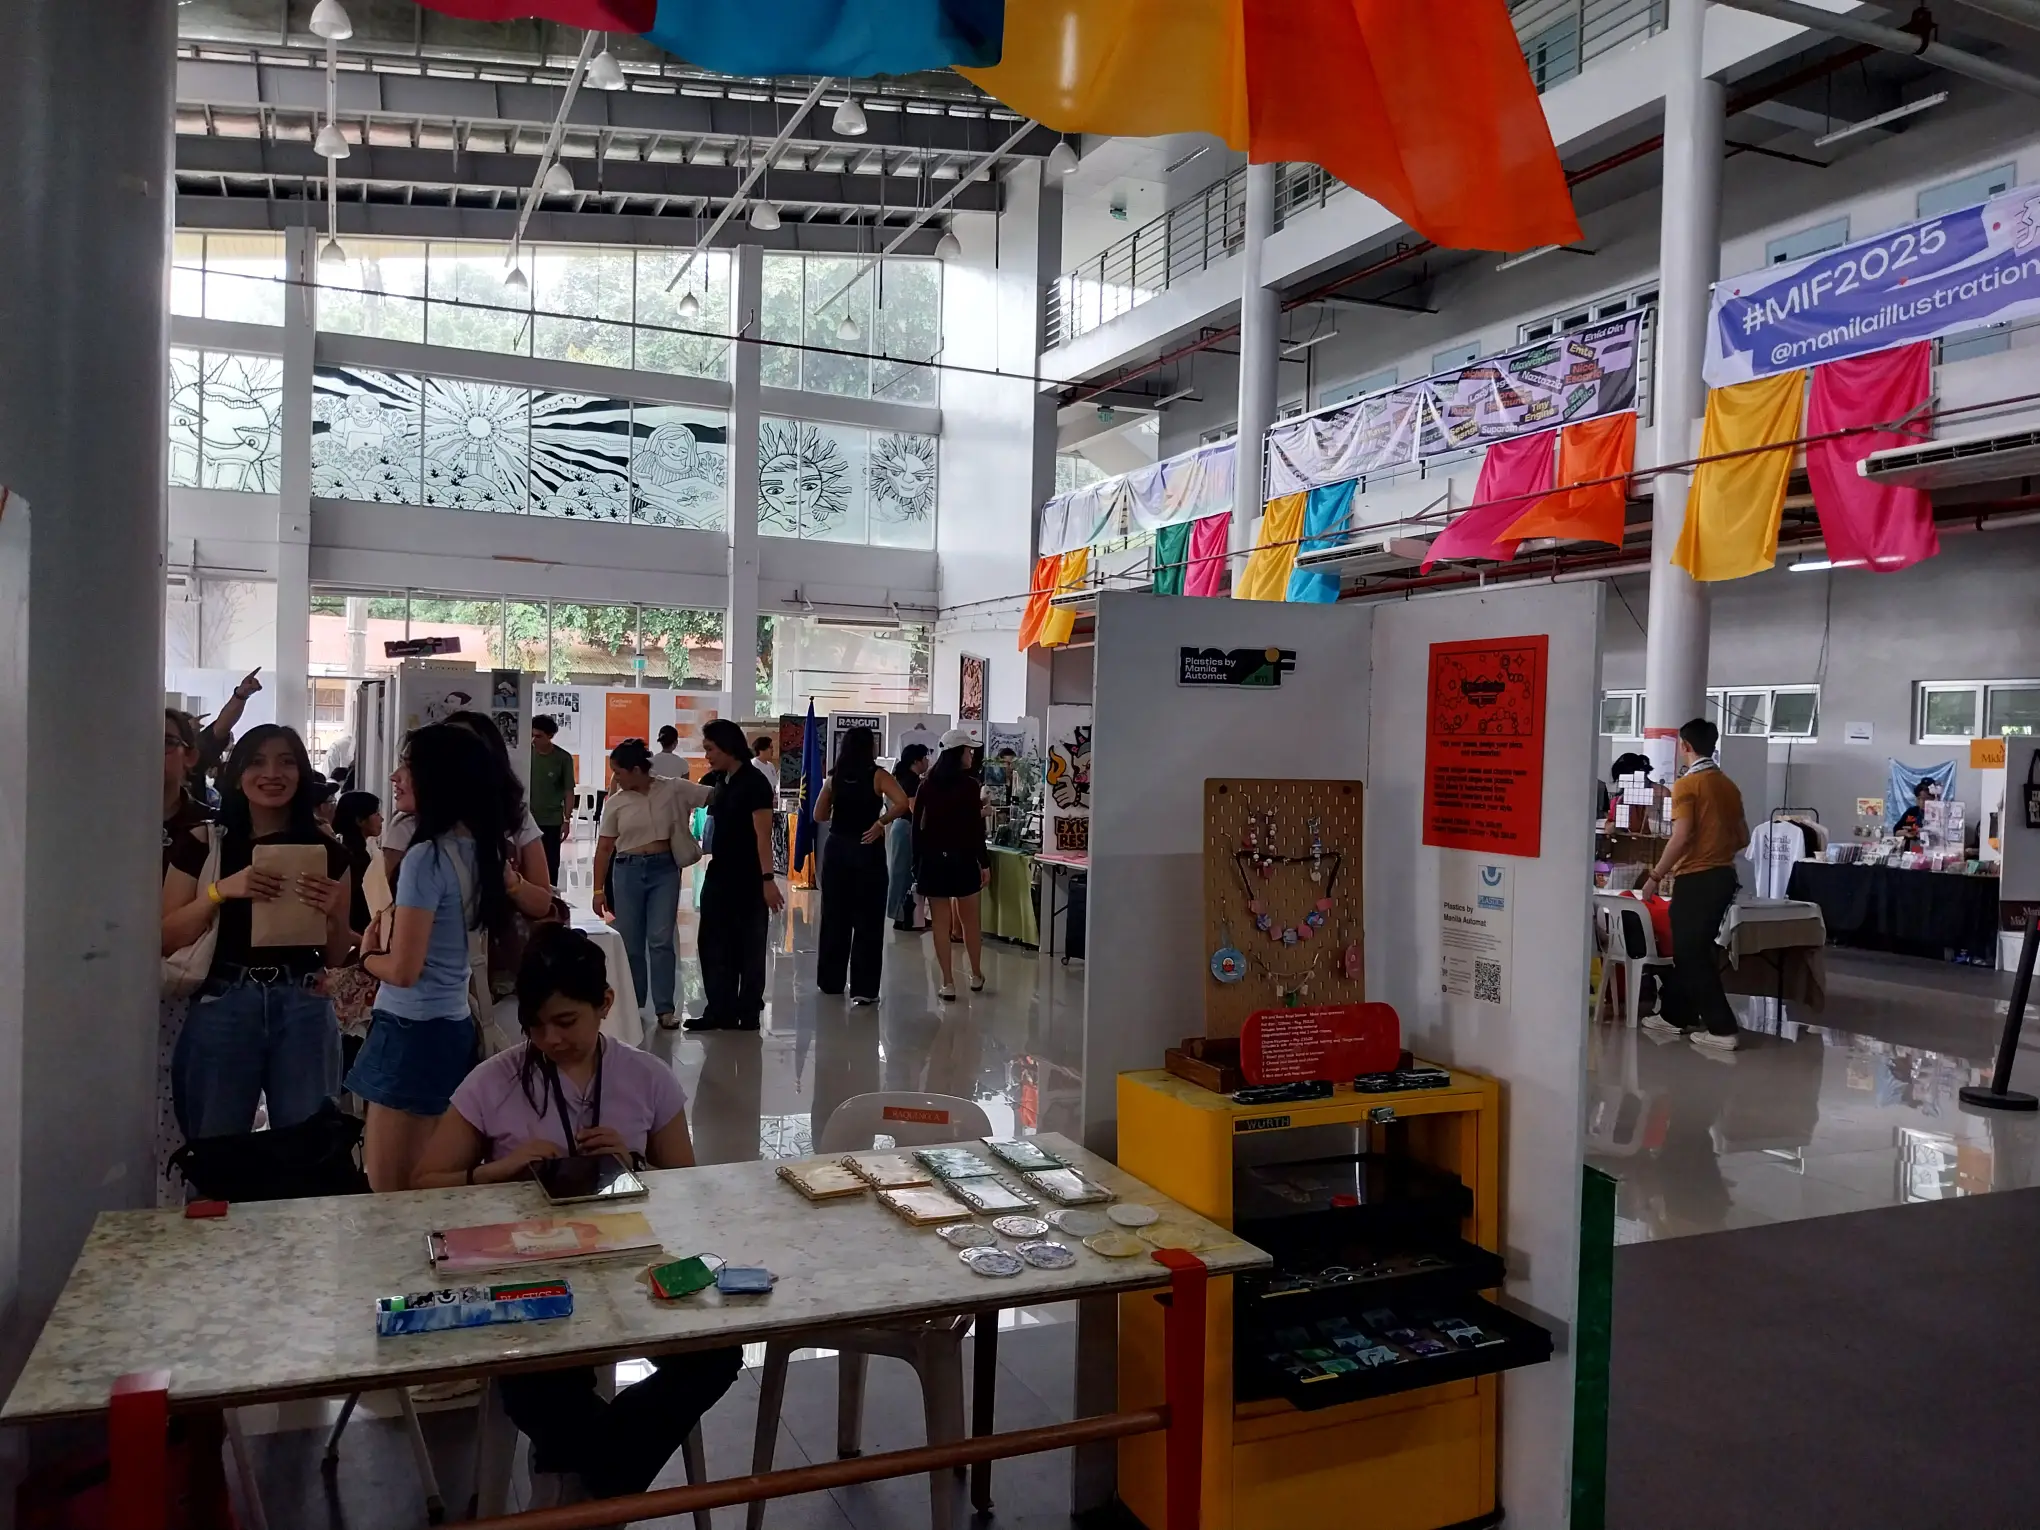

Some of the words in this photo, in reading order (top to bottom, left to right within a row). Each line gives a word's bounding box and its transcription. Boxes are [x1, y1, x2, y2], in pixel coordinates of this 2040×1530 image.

[1742, 220, 1947, 335] #MIF2025
[1771, 258, 2040, 365] @manilaillustration
[1584, 327, 1607, 342] Enid
[1607, 323, 1624, 335] Din
[1569, 343, 1593, 358] Emte
[1530, 400, 1550, 413] Tiny
[1524, 408, 1555, 421] Engine
[1185, 657, 1223, 666] Plastics
[1224, 658, 1237, 668] by
[1185, 665, 1217, 673] Manila
[1184, 672, 1228, 681] Automat
[1443, 902, 1466, 912] Plastics
[1467, 905, 1474, 914] by
[1443, 913, 1462, 923] Manila
[1462, 917, 1487, 927] Automat
